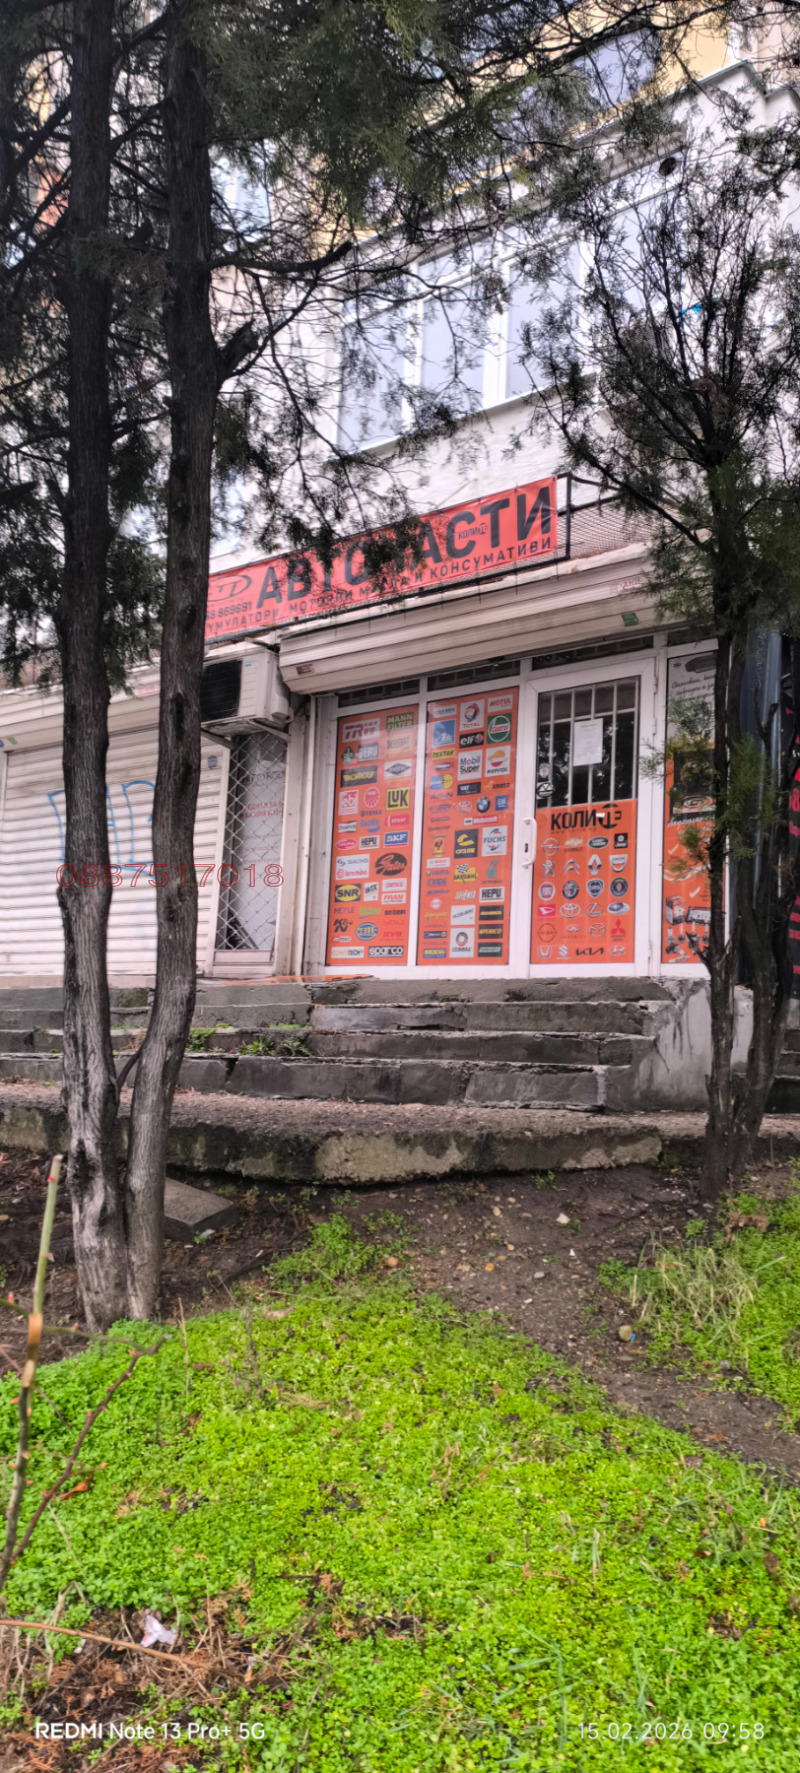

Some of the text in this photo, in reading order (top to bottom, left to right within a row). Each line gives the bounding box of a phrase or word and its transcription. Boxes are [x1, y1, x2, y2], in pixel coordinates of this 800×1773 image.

[256, 486, 550, 608] АВТОАСТИ
[430, 537, 551, 579] КОНСУМАТИВИ
[387, 713, 414, 724] MANN
[345, 721, 377, 739] TRW
[387, 721, 413, 731] FILTER
[460, 736, 474, 745] elf
[460, 756, 480, 766] Mobil
[460, 765, 480, 774] Super
[386, 833, 407, 842] SKF
[483, 836, 506, 844] FUCHS
[337, 888, 359, 898] SNR
[481, 888, 502, 898] HEPU
